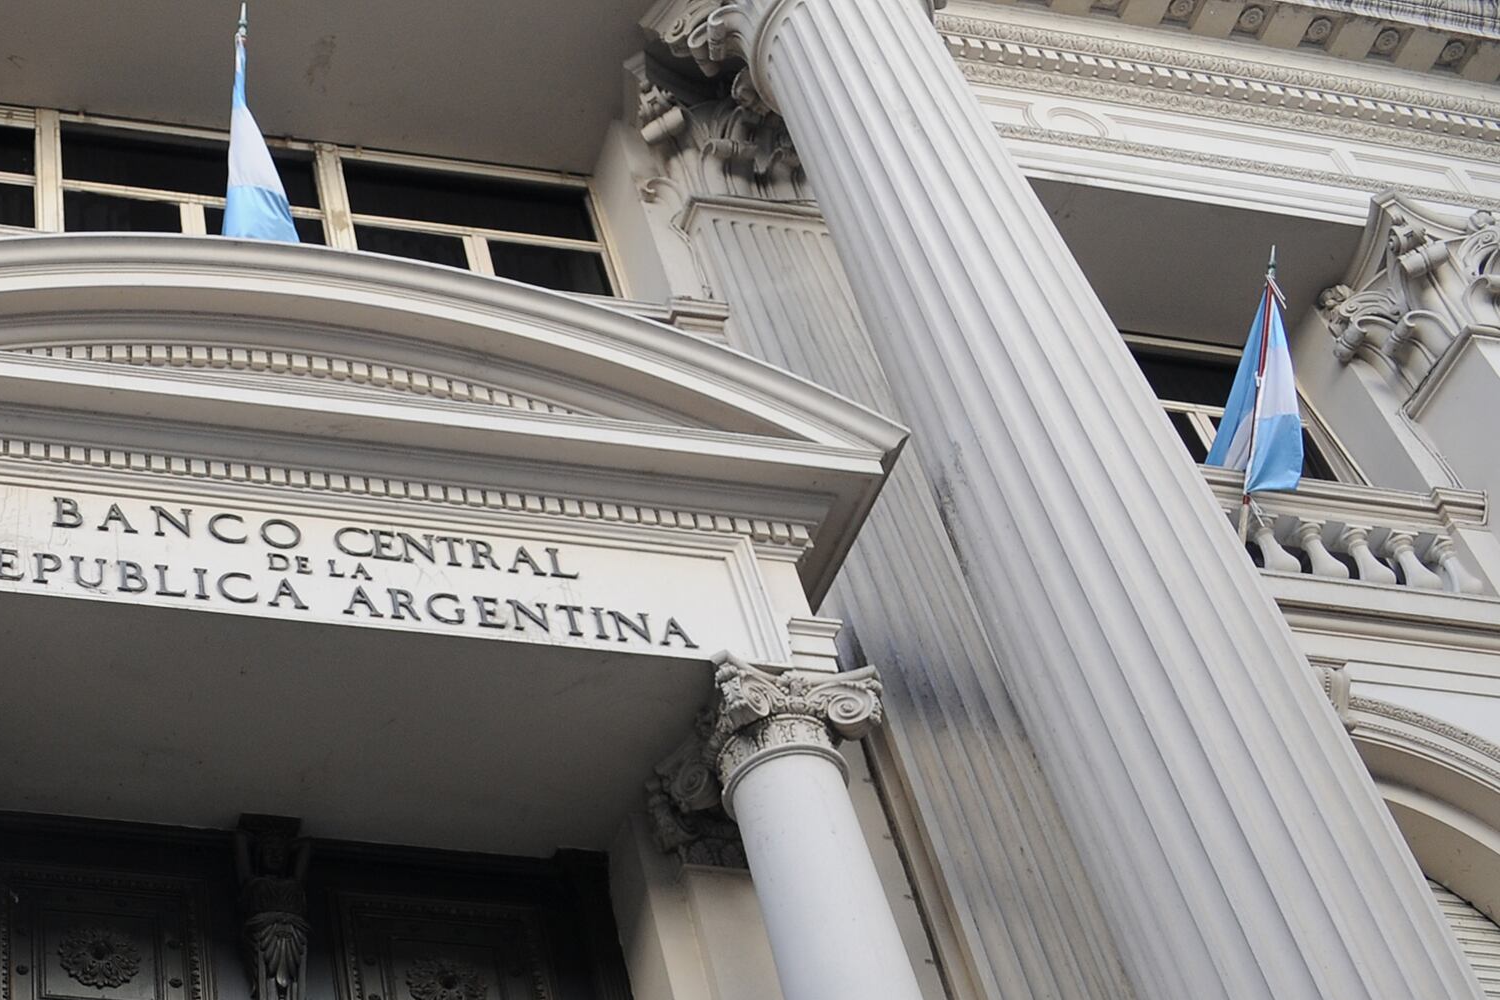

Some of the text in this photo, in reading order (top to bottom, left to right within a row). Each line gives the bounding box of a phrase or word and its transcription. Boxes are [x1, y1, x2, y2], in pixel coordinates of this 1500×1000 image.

[52, 496, 579, 579] BANCO CENTRAL
[267, 552, 373, 581] DE LA
[342, 585, 700, 649] ARGENTINA
